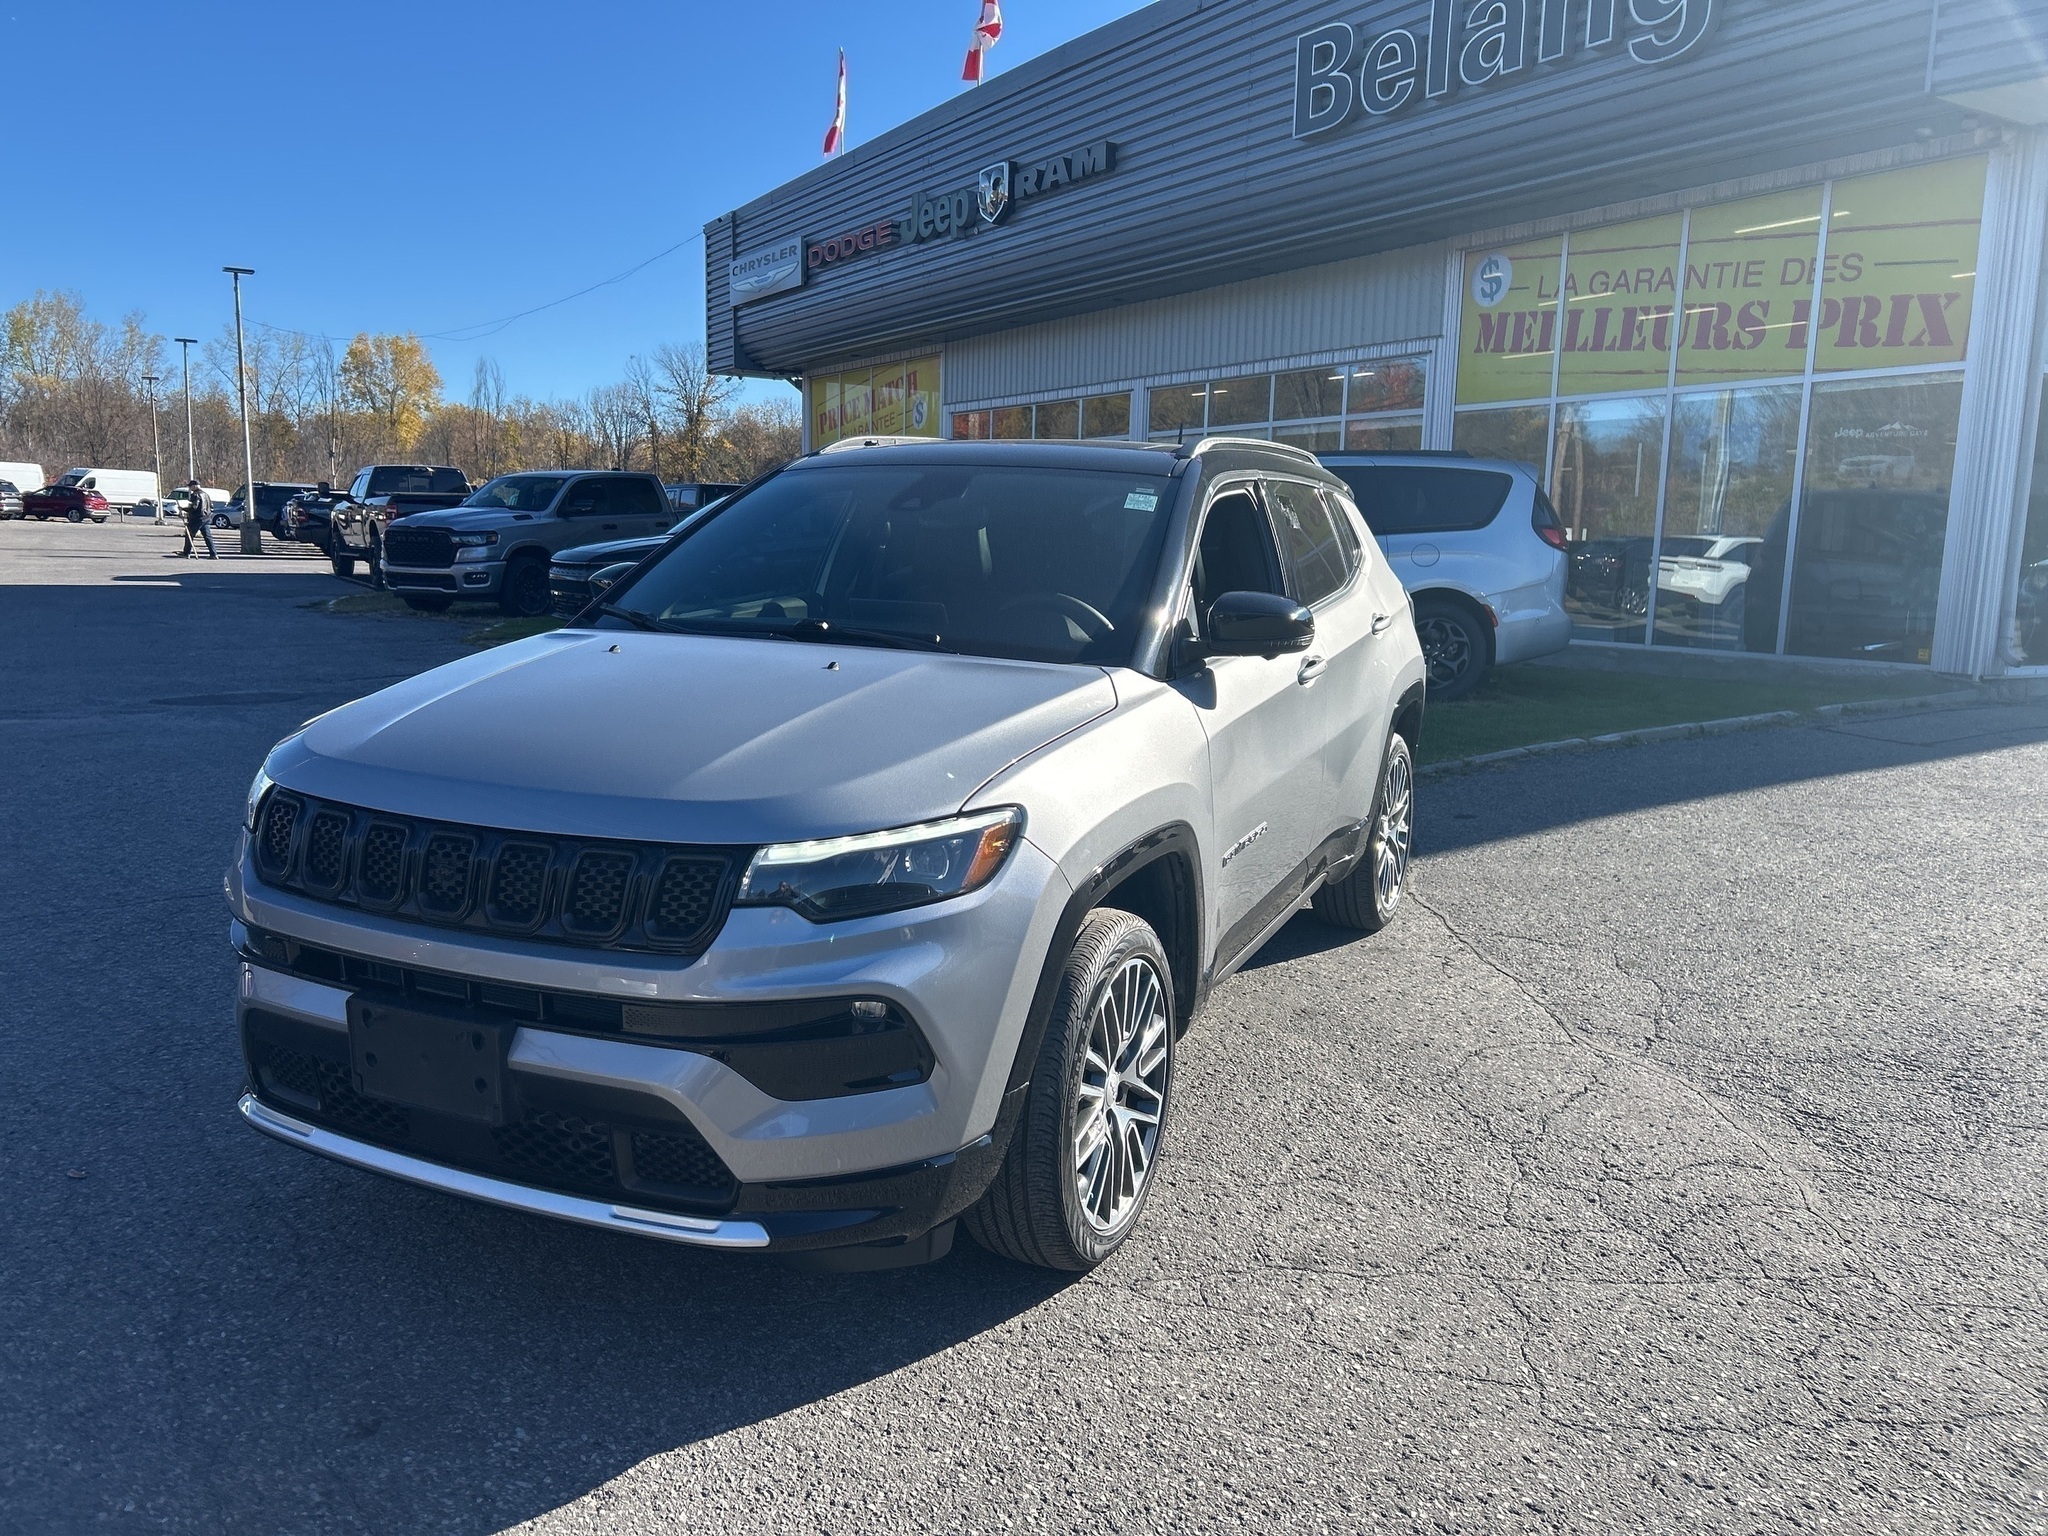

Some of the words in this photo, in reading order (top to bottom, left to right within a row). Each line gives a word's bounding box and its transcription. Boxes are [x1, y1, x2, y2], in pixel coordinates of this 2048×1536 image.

[1014, 141, 1108, 200] RAM
[899, 189, 970, 244] Jeep
[732, 244, 798, 277] CHRYSLER
[808, 220, 893, 269] DODGE
[1537, 267, 1579, 298] LA
[1588, 260, 1766, 295] GARANTIE
[1473, 300, 1771, 354] MEILLEURS
[1785, 292, 1962, 349] PRIX
[819, 396, 861, 436] PRICE
[863, 370, 918, 416] MATCH
[1834, 426, 1864, 438] Jeep
